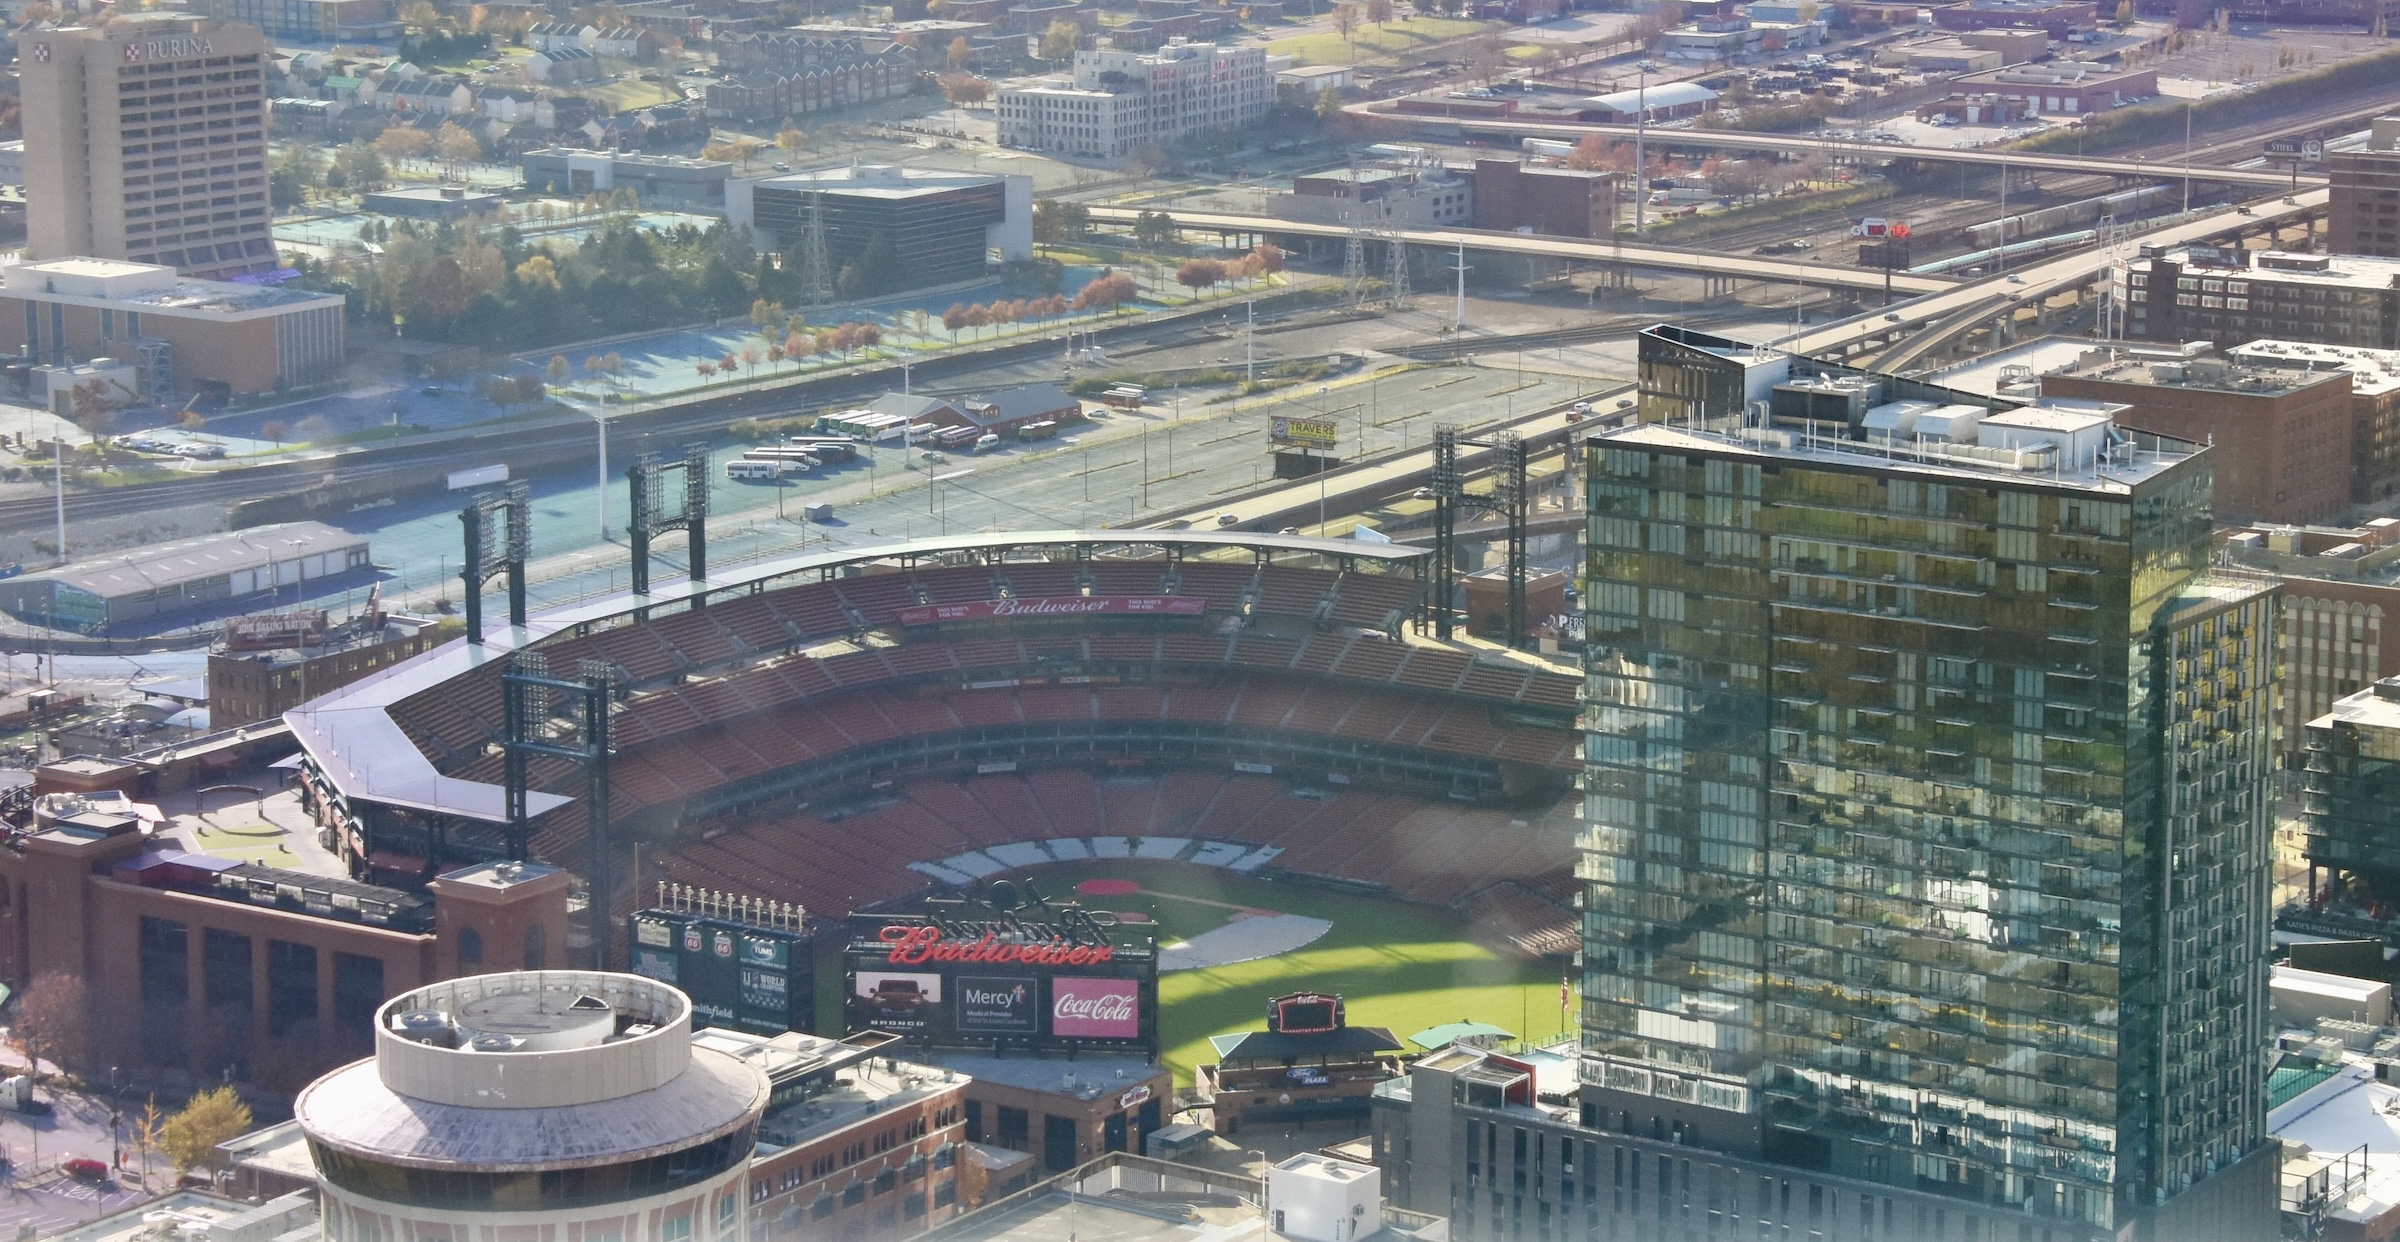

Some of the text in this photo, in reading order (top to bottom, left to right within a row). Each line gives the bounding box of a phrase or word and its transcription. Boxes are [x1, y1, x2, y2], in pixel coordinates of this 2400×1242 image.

[147, 38, 213, 60] PURINA
[1290, 422, 1335, 436] TRAVERS
[987, 598, 1110, 616] Budweiser
[2312, 925, 2332, 933] PIZZA
[2338, 929, 2360, 937] PASTA
[688, 938, 701, 949] 66
[719, 943, 731, 955] 66
[880, 926, 1112, 964] Budweiser
[755, 946, 773, 956] TUMS
[760, 974, 785, 986] WORLD
[966, 989, 1014, 1008] Mercy
[691, 1003, 733, 1018] mithfield
[870, 1019, 924, 1027] BRONCO
